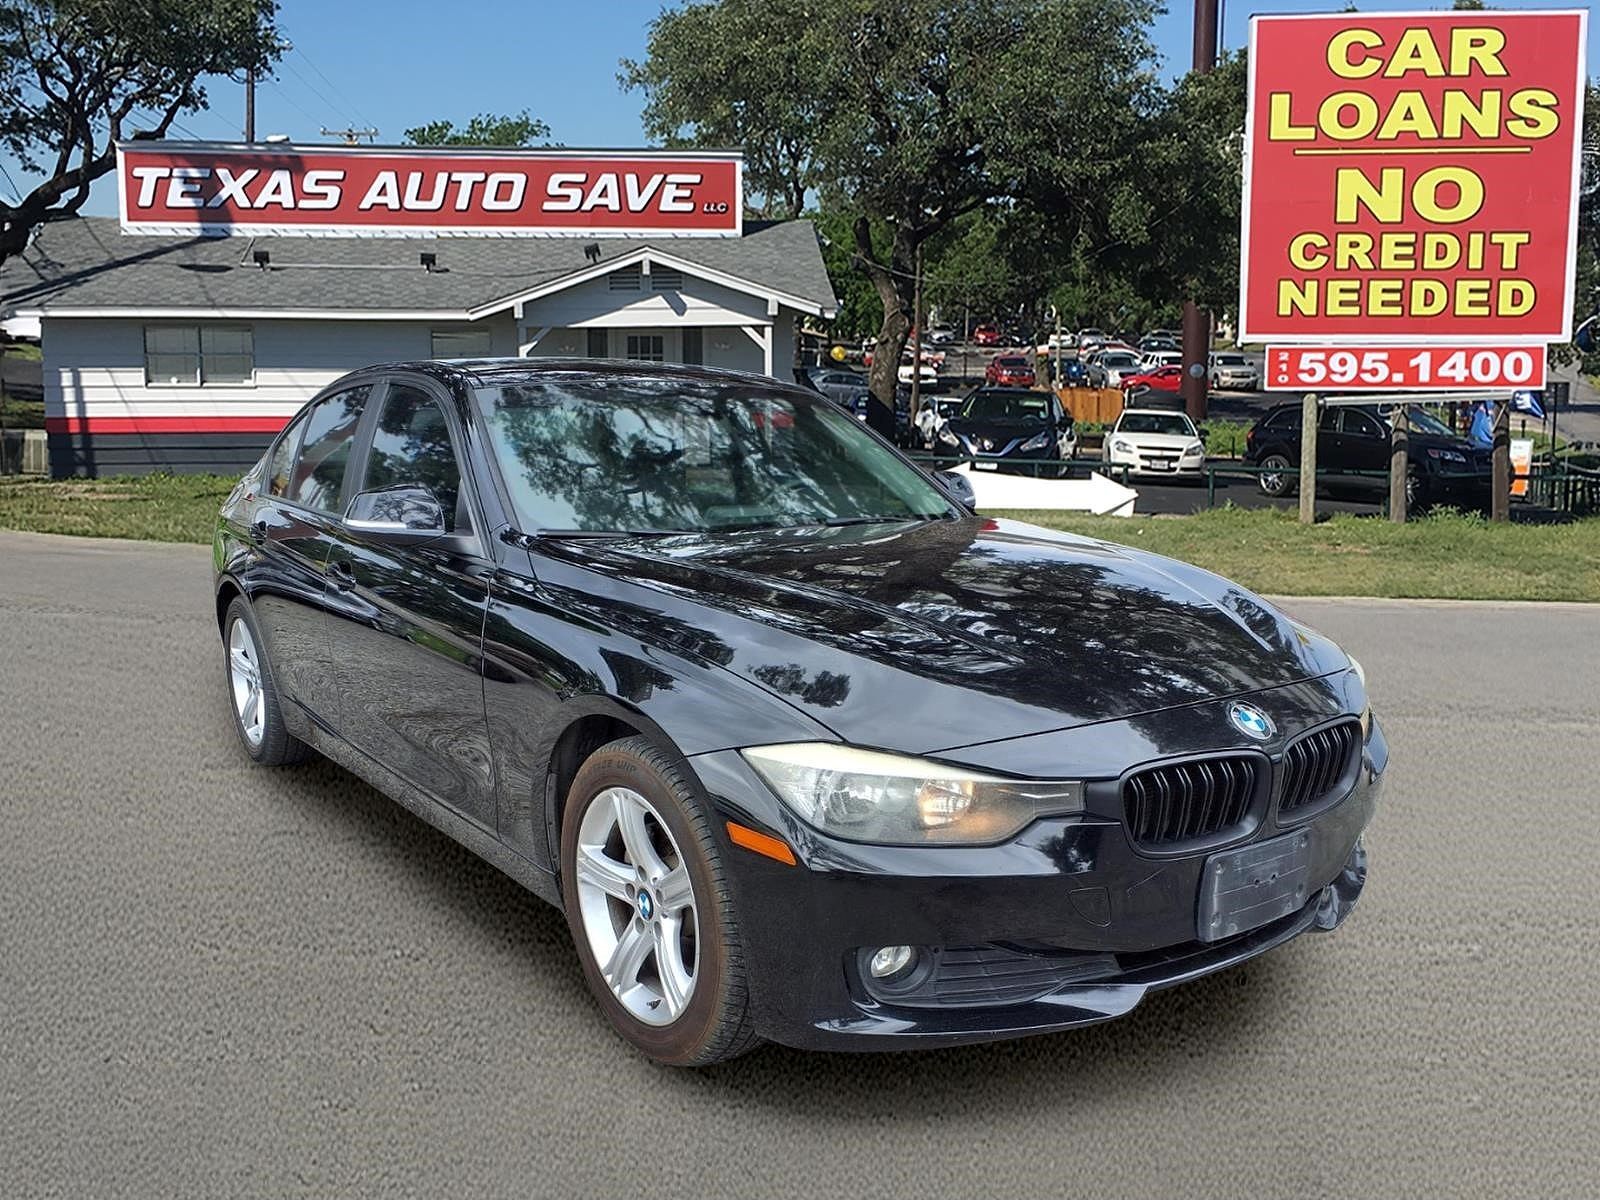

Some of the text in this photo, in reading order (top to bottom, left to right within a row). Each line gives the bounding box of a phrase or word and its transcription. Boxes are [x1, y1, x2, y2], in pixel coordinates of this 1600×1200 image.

[1326, 27, 1509, 79] CAR
[1268, 88, 1560, 141] LOANS
[131, 167, 728, 214] TEXAS AUTO SAVE LLC
[1335, 166, 1485, 224] NO
[1288, 231, 1530, 271] CREDIT
[1277, 278, 1537, 317] NEEDED
[1296, 351, 1534, 384] 595.1400
